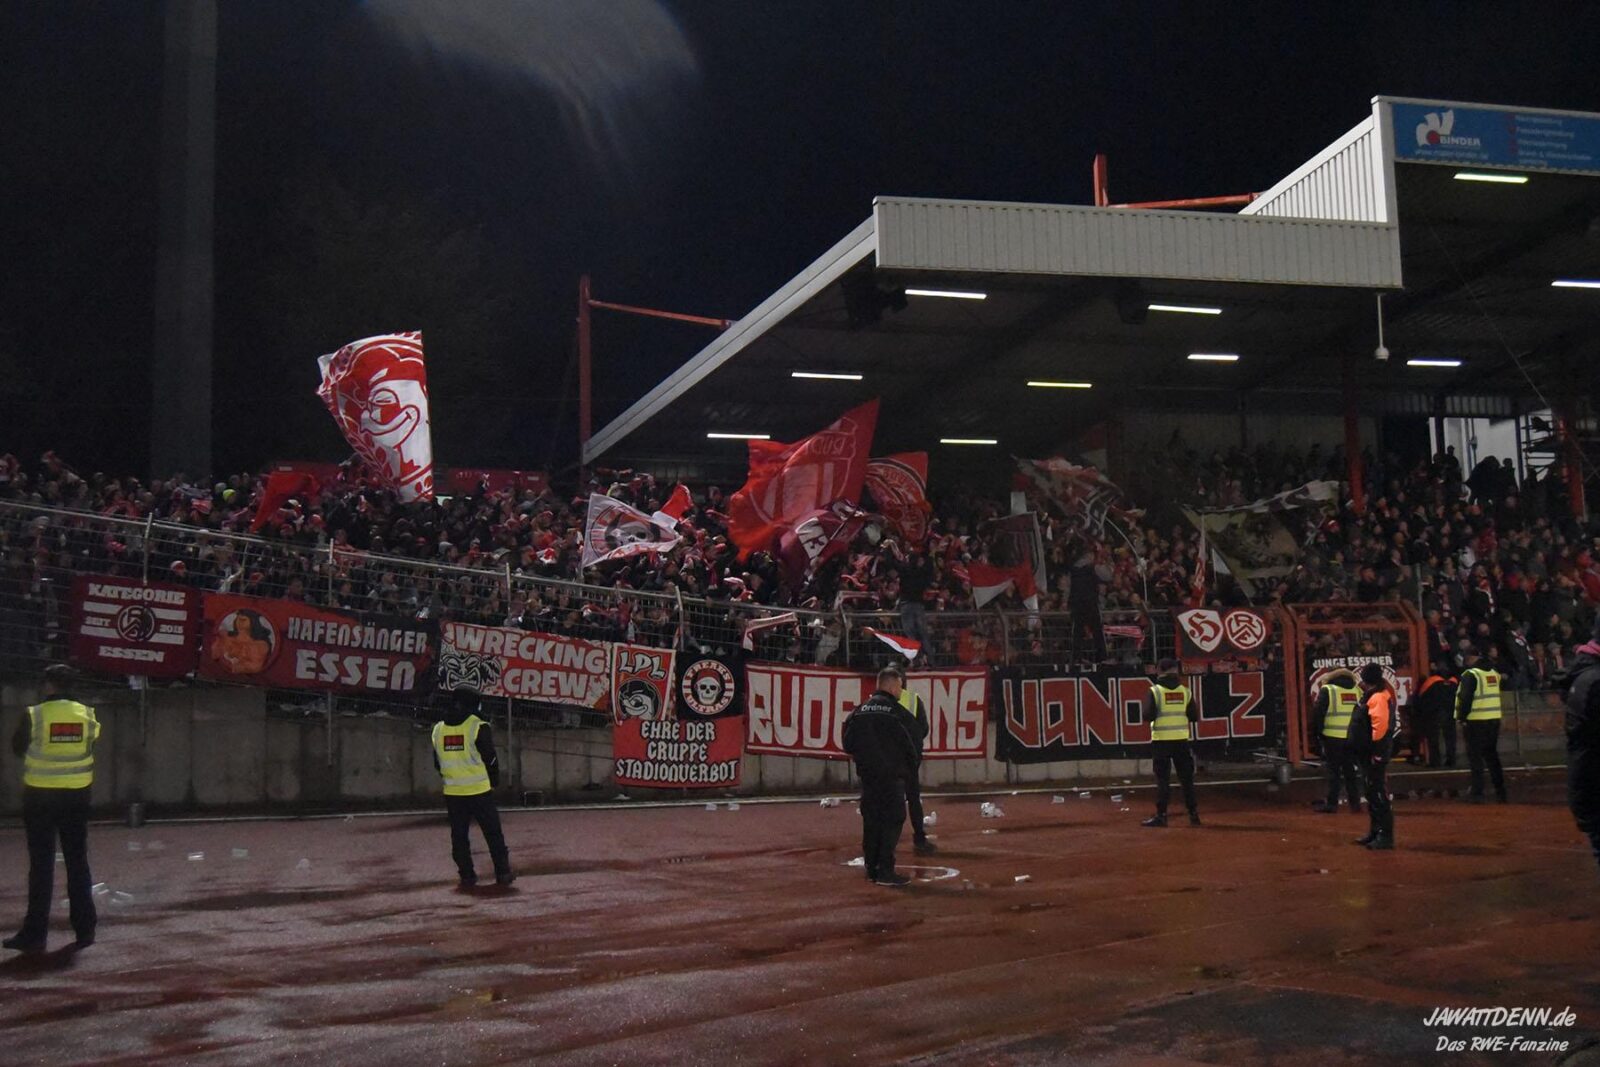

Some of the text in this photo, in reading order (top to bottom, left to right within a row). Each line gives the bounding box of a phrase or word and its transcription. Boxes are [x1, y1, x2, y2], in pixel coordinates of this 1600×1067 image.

[88, 583, 186, 605] KATEGORIE
[288, 617, 427, 654] HAFENSÄNGER
[98, 645, 165, 662] ESSEN
[454, 625, 606, 674] WRECKING
[296, 649, 416, 690] ESSEN
[1312, 657, 1346, 669] JUNGE
[503, 669, 591, 699] CREW
[748, 671, 862, 749] RUDE
[861, 703, 892, 713] Ordner
[1003, 671, 1266, 748] VANDLZ
[641, 721, 716, 741] EHRE DER
[616, 759, 737, 782] STADIONVERBOT
